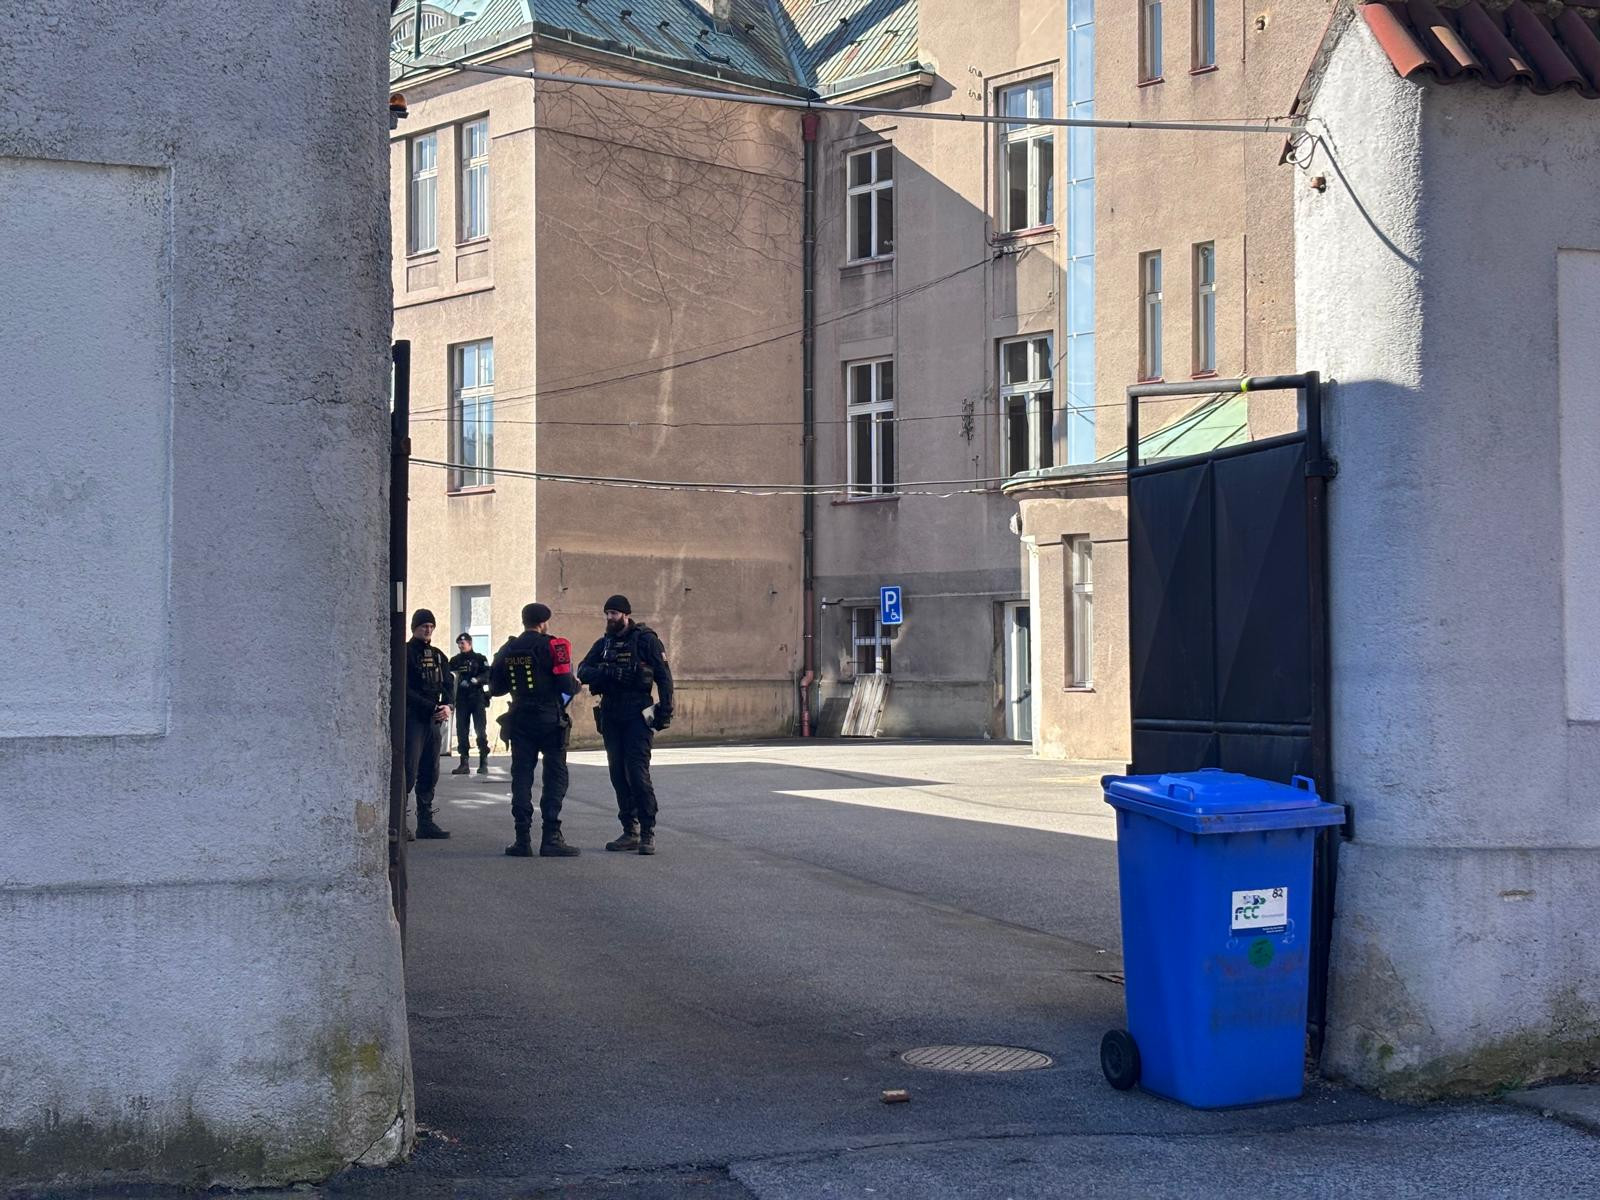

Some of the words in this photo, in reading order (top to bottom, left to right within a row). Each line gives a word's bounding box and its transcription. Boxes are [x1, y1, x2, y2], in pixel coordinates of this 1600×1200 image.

[885, 591, 897, 613] P
[504, 656, 533, 666] POLICIE
[1272, 888, 1284, 899] 82
[1234, 906, 1261, 921] FCC
